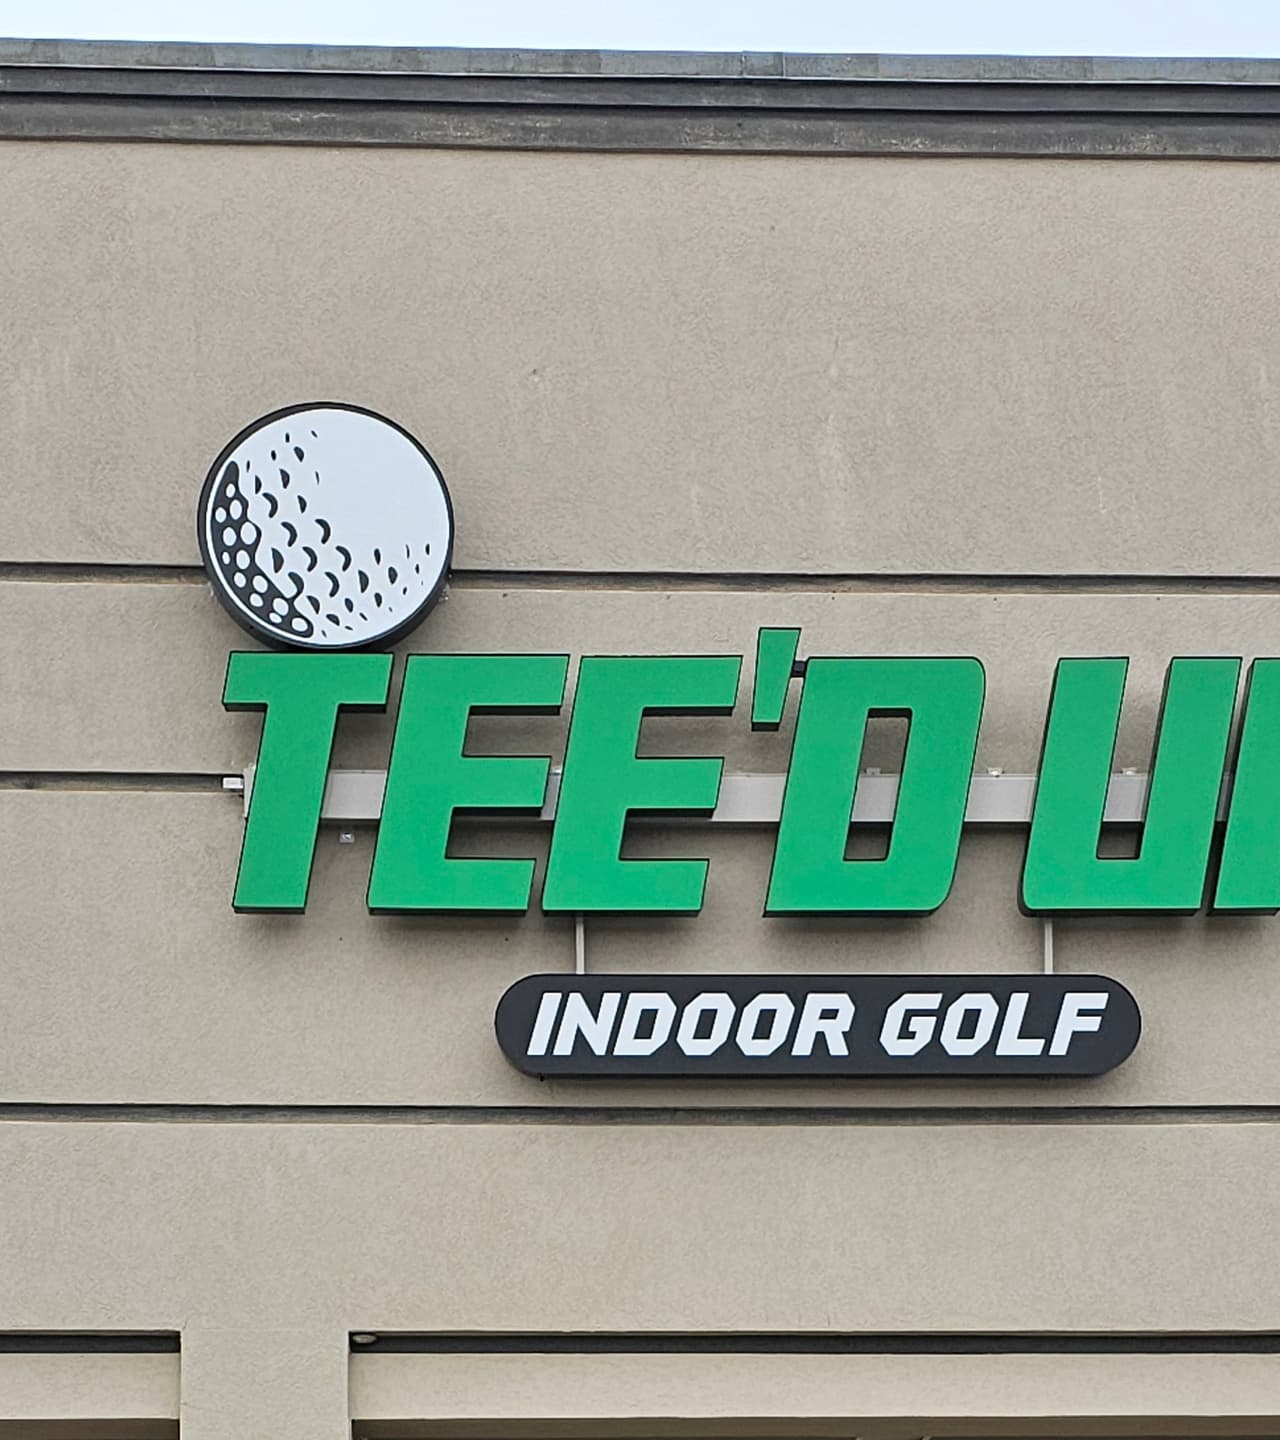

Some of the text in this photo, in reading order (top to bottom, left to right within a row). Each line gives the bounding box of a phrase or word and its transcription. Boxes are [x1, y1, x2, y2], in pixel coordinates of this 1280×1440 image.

[222, 628, 986, 916] TEE'D
[526, 991, 1110, 1057] INDOOR GOLF
